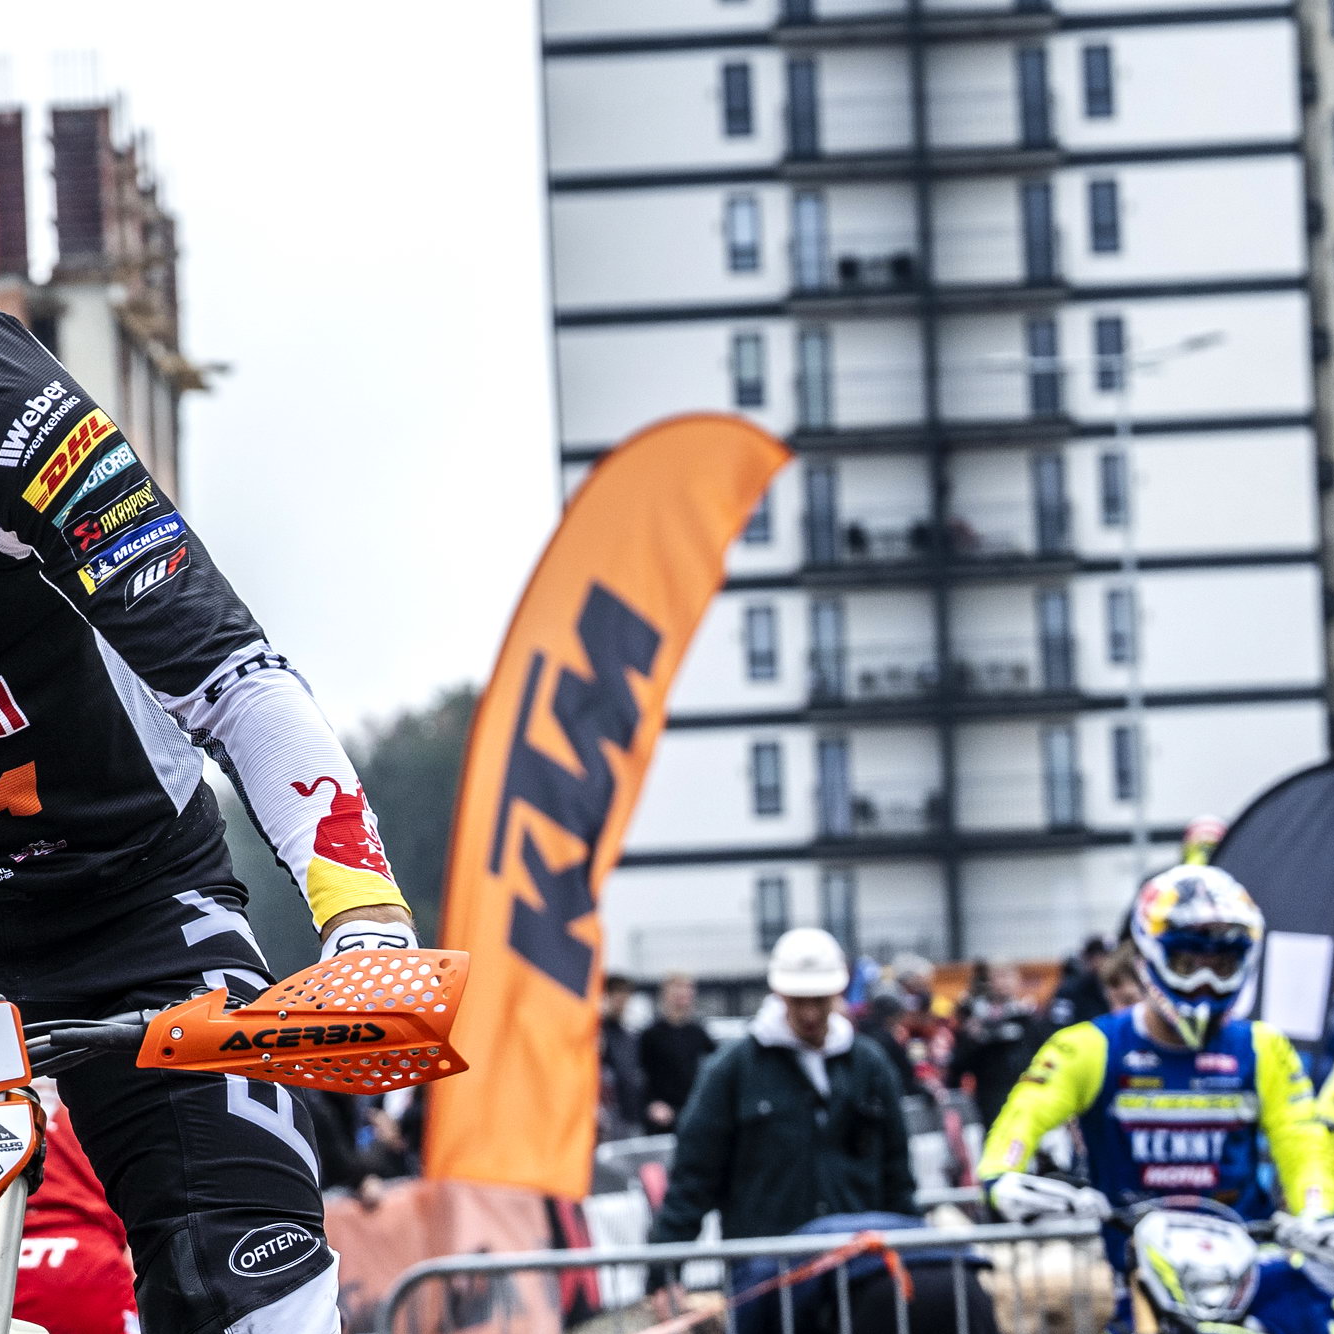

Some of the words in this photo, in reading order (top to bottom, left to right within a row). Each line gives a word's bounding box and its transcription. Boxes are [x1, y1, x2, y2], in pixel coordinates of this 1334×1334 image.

[40, 416, 108, 496] DHL
[113, 520, 180, 563] MICHELIN
[487, 574, 665, 1001] KTM
[219, 1022, 386, 1052] ACERBIS
[240, 1232, 308, 1269] ORTEM
